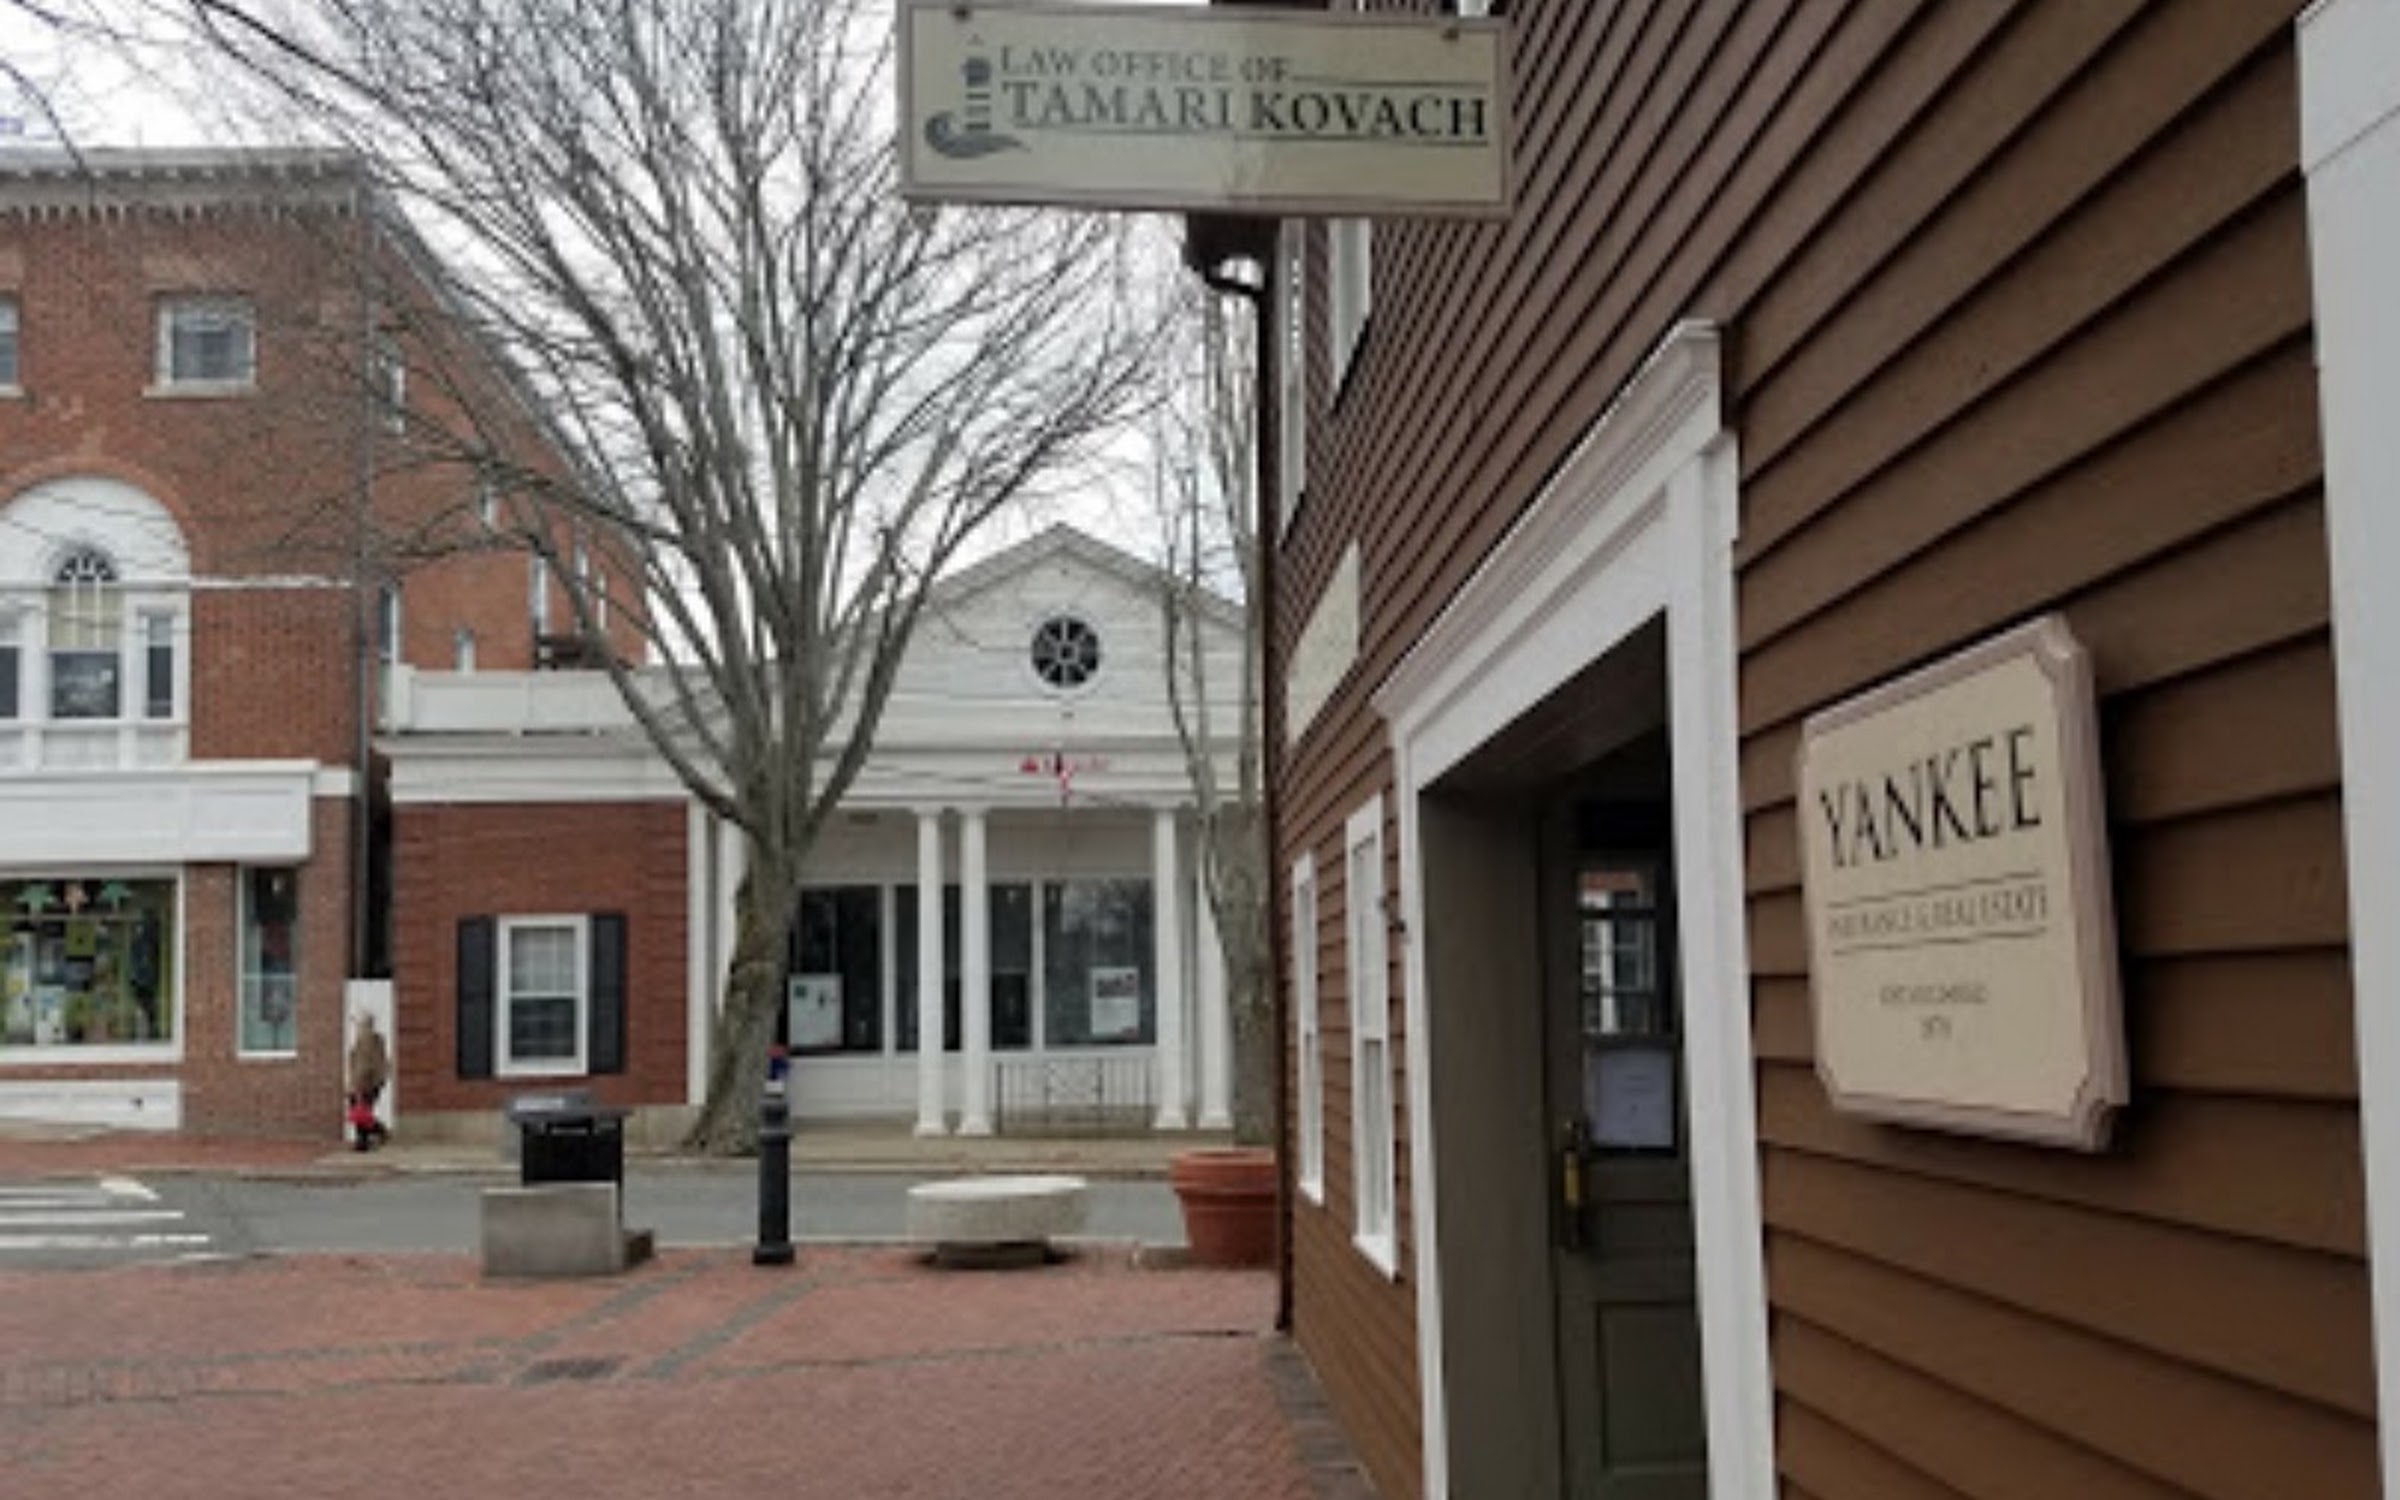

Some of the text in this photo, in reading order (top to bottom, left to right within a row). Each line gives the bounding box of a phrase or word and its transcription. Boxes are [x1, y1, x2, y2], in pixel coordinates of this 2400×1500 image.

[1002, 46, 1288, 84] LAW OFFICE OF
[1003, 82, 1487, 139] TAMARI KOVACH
[1819, 724, 2042, 868] YANKEE
